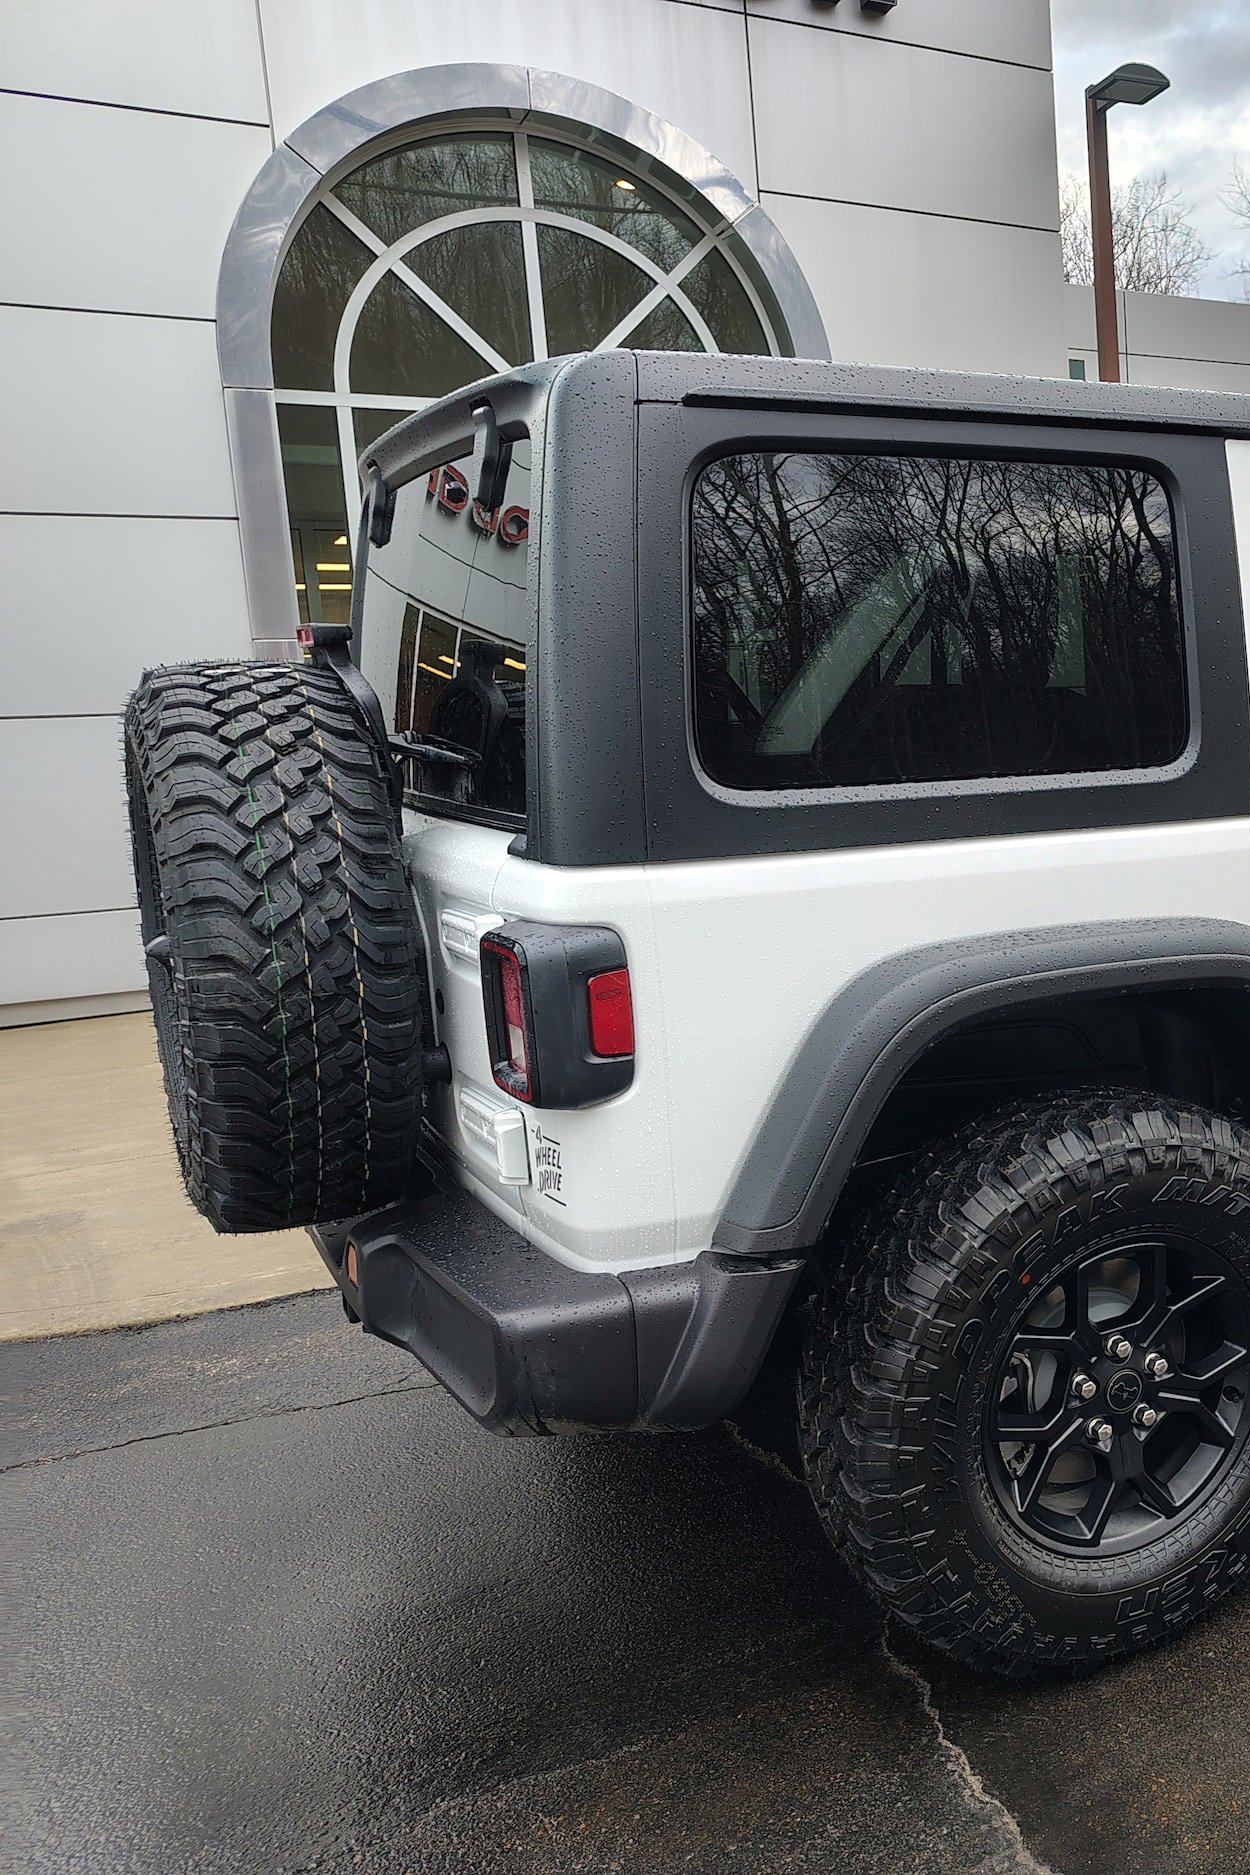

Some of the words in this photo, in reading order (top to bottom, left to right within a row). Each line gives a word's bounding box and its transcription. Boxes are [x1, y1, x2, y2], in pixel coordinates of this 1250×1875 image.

[535, 1124, 543, 1145] 4
[535, 1146, 562, 1170] WHEEL
[538, 1169, 562, 1194] DRIVE
